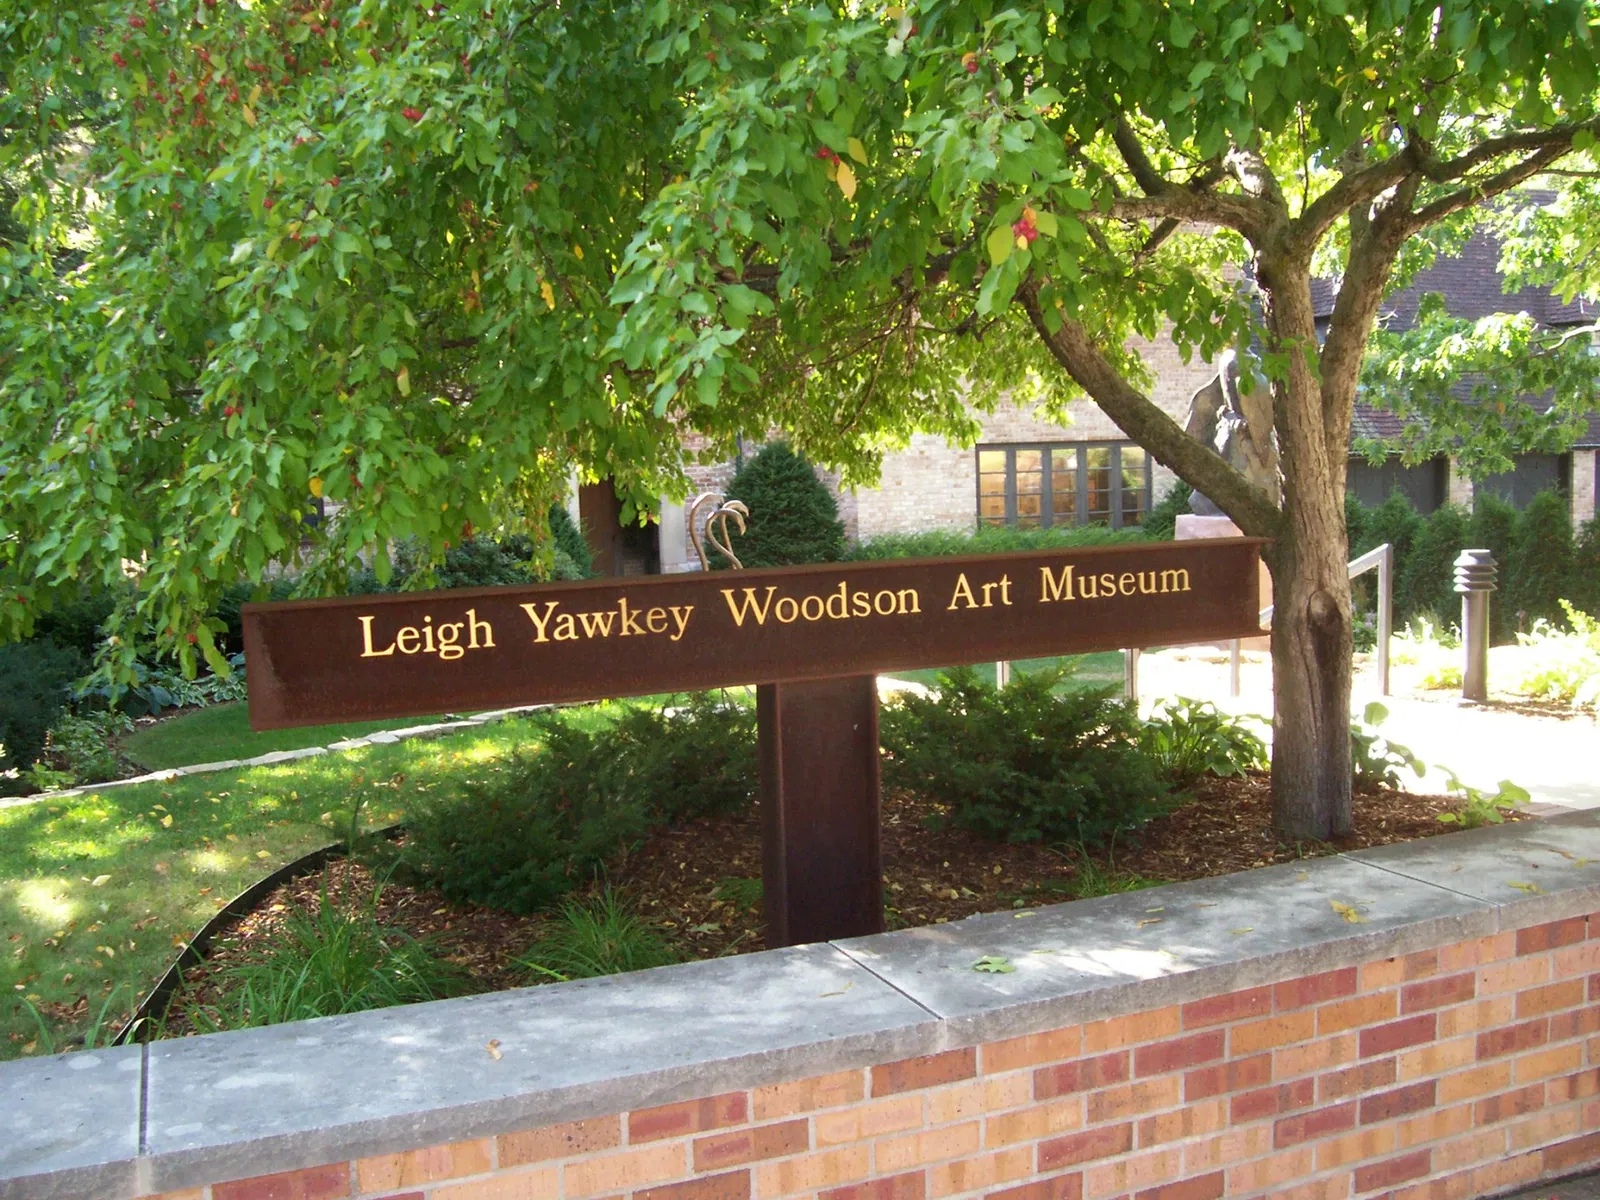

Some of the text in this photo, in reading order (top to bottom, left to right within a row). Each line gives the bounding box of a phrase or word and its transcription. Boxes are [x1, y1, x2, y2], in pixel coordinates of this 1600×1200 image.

[358, 565, 1193, 661] Leigh Yawkey Woodson Art Museum
